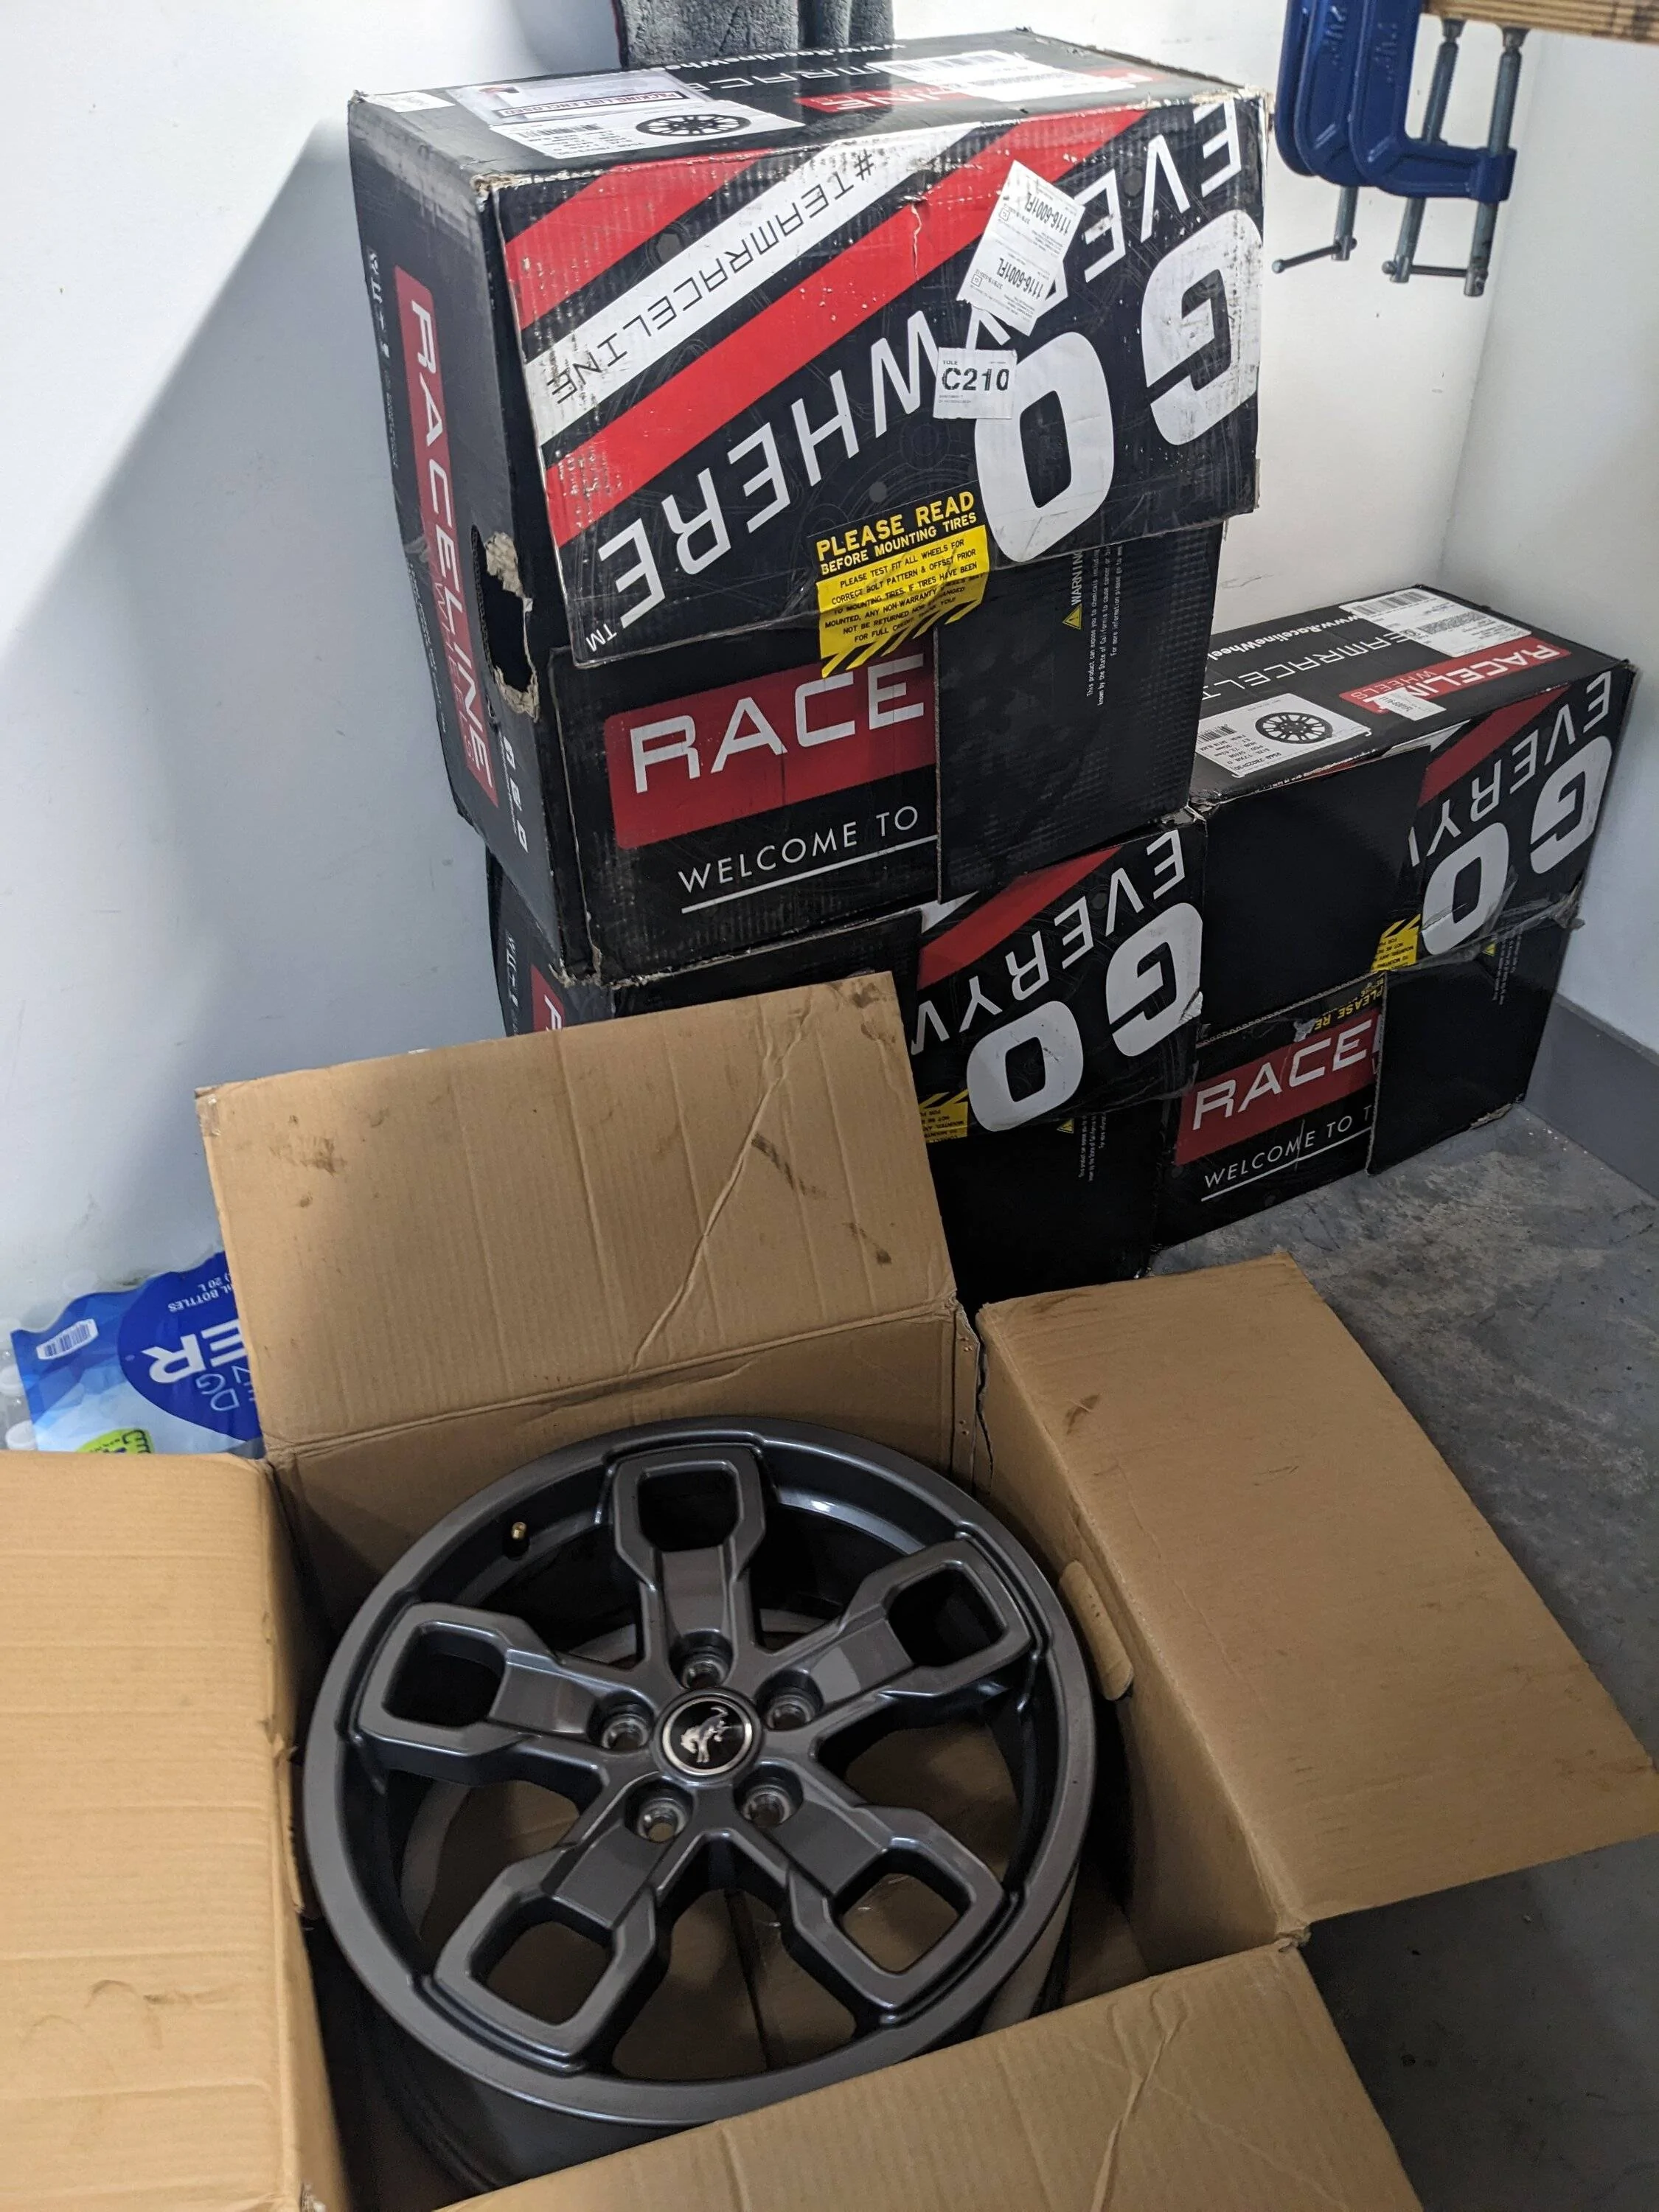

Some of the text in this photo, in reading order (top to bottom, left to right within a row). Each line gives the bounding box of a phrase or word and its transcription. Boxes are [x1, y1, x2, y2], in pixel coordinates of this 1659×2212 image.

[618, 92, 675, 103] PACKING
[995, 257, 1046, 300] 1116-6001FL
[599, 101, 1242, 629] EVEYWHERE
[942, 367, 1009, 391] C210
[973, 209, 1261, 566] GO
[411, 299, 493, 787] RACELINE
[816, 491, 975, 561] PLEASE READ
[821, 512, 976, 575] BEFORE MOUNTING TIRES
[832, 588, 863, 605] CORRECT
[867, 581, 883, 593] BOLT
[887, 569, 917, 584] PATTERN
[930, 556, 953, 571] OFFSET
[957, 549, 976, 560] PRIOR
[841, 539, 964, 588] PLEASE TEST FIT ALL WHEELS FOR
[846, 596, 882, 611] MOUNTING
[917, 577, 936, 588] TIRES
[939, 568, 957, 580] HAVE
[960, 562, 977, 573] BEEN
[844, 625, 858, 634] NOT
[874, 611, 909, 626] RETURNED
[865, 608, 880, 618] ANY
[883, 588, 936, 611] NON-WARRANTY
[855, 633, 868, 642] FOR
[872, 628, 888, 637] FULL
[1100, 644, 1105, 653] of
[1351, 669, 1436, 700] WHEELS
[630, 653, 925, 793] RACE
[1408, 670, 1611, 866] EVERY
[678, 806, 919, 893] WELCOME TO
[1422, 736, 1613, 955] GO
[966, 902, 1203, 1132] GO
[1338, 986, 1385, 1019] PLEASE
[1204, 1130, 1316, 1189] WELCOME
[1326, 1116, 1352, 1141] TO
[168, 1290, 220, 1312] BOTTLES
